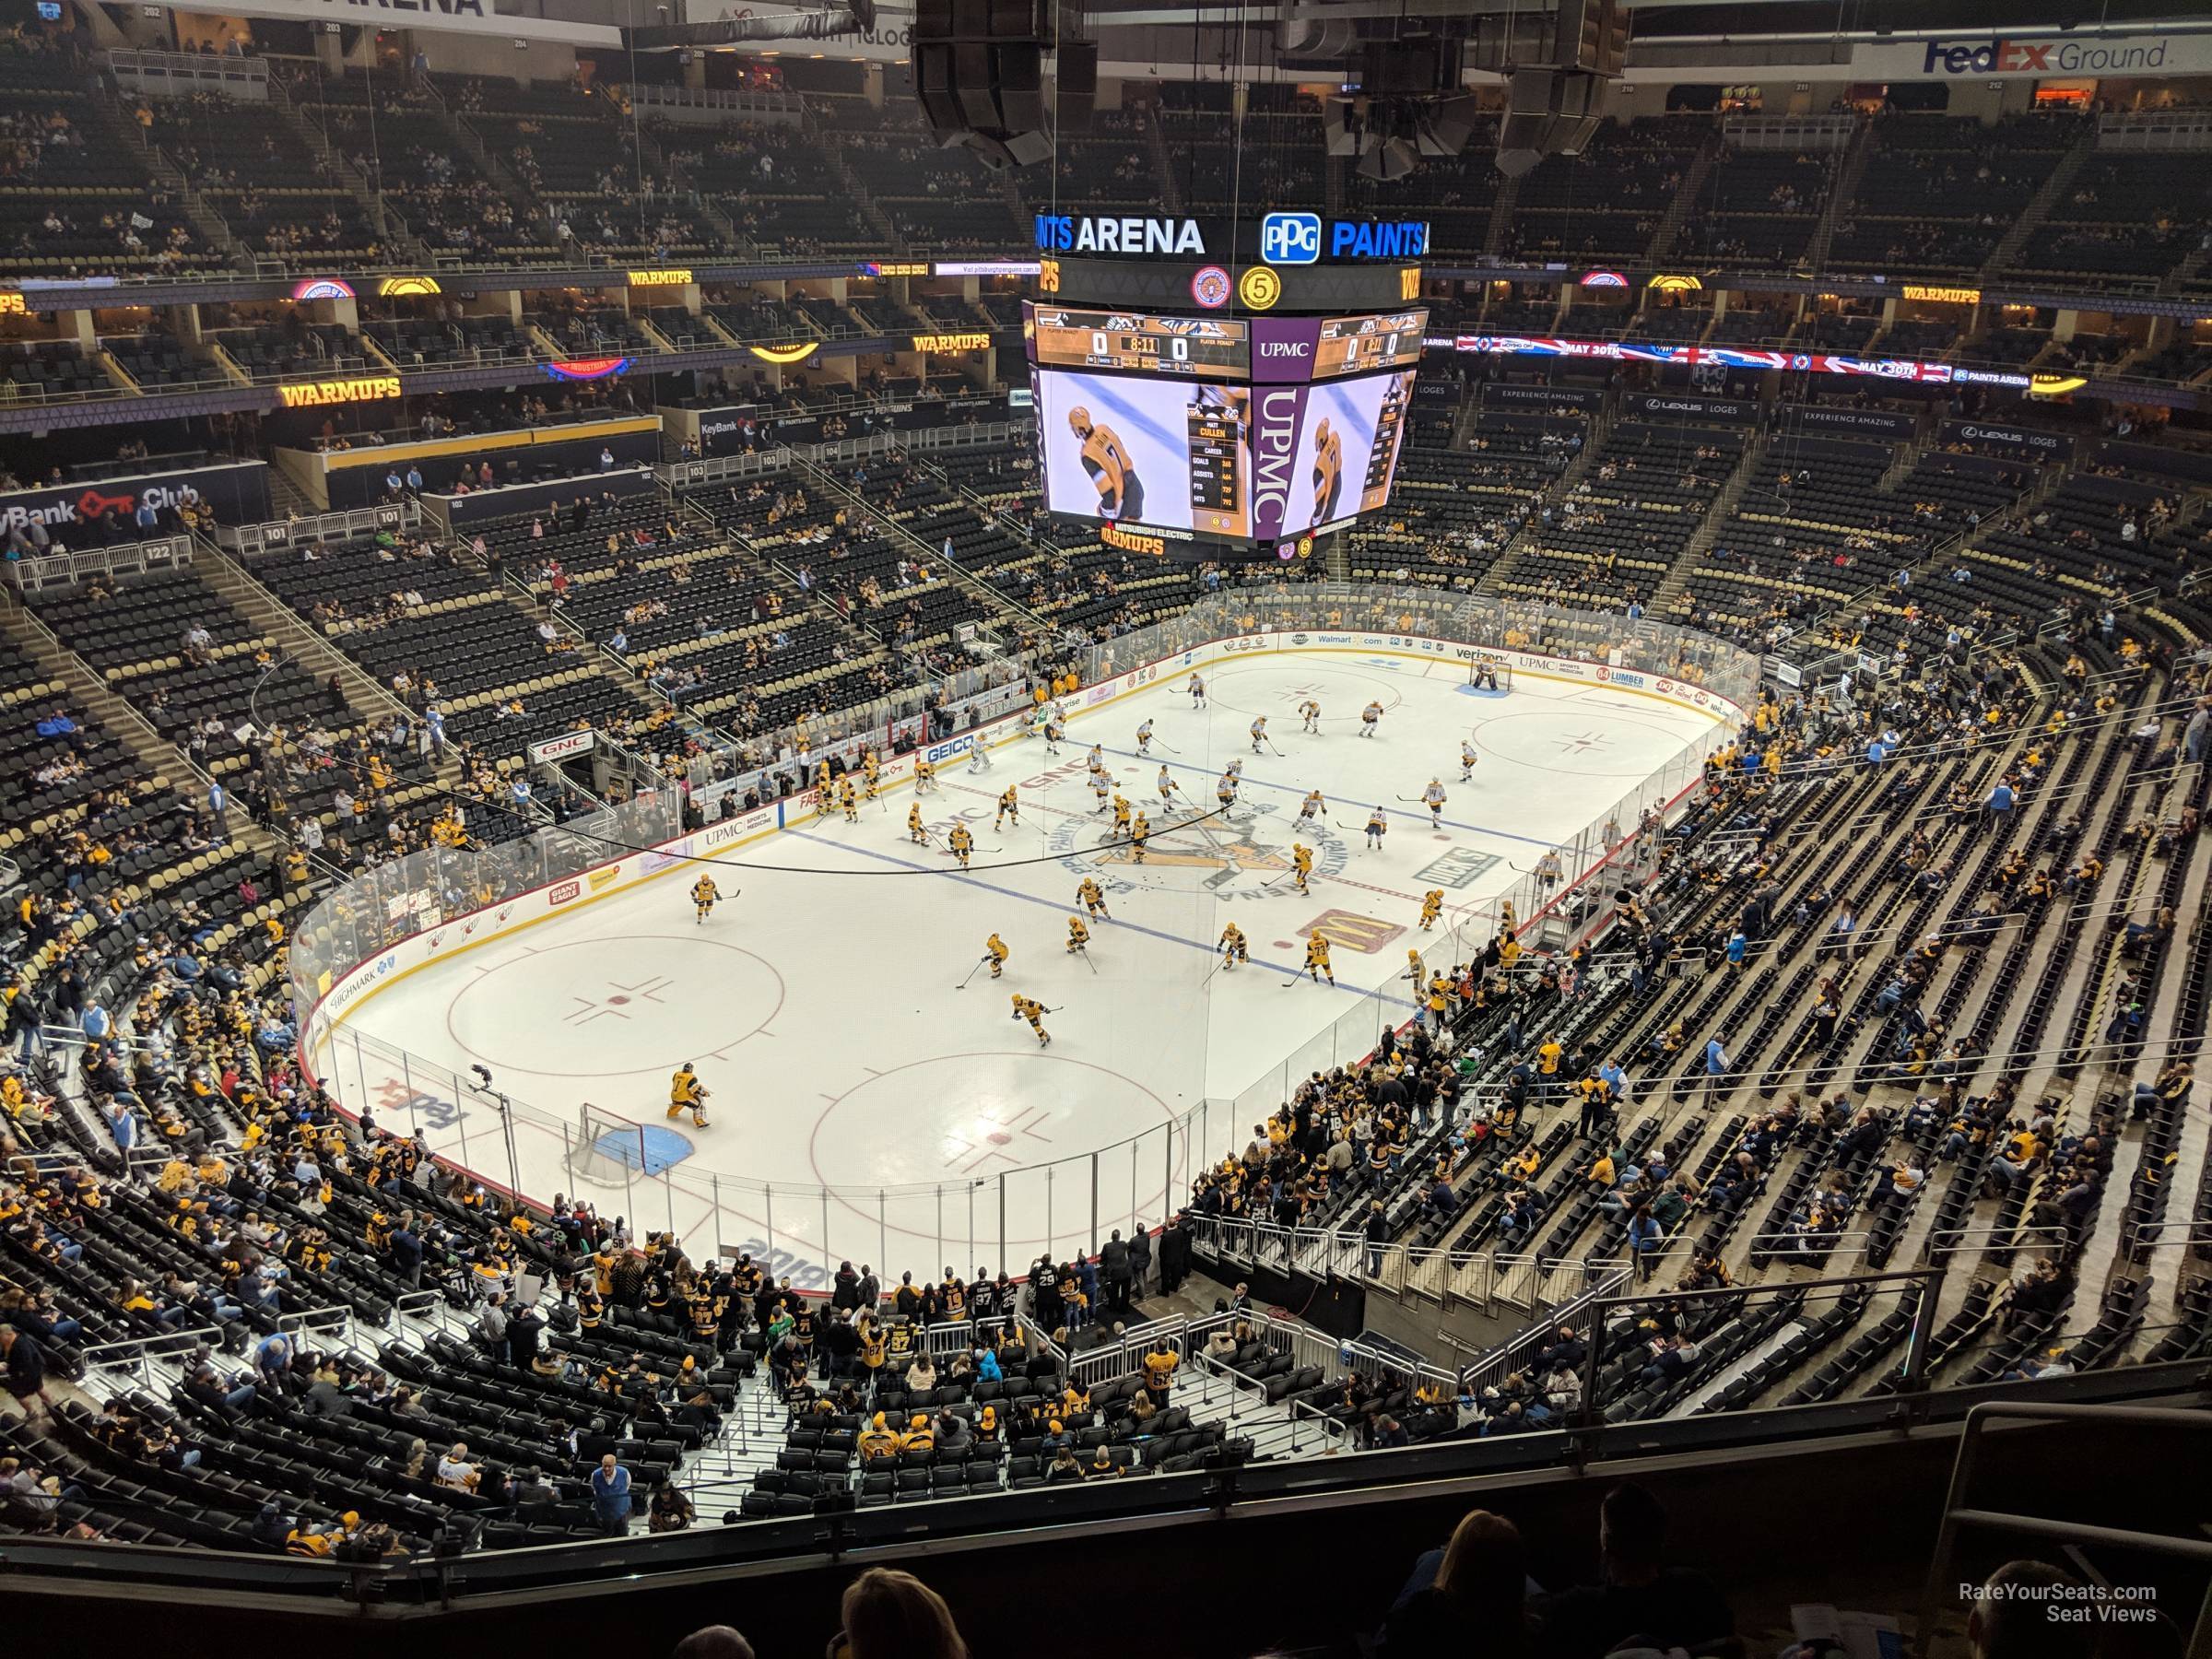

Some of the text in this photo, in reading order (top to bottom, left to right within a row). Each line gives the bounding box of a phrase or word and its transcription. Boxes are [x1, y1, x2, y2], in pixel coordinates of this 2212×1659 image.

[144, 7, 160, 17] 202
[326, 23, 340, 32] 203
[515, 40, 527, 48] 204
[1924, 40, 2168, 73] FedEx Ground
[1077, 218, 1206, 253] ARENA
[1265, 219, 1422, 258] PPG PAINTS
[628, 270, 693, 286] WARMUPS
[1253, 278, 1267, 299] 5
[1902, 286, 1981, 303] WARMUPS
[912, 335, 990, 351] WARMUPS
[1092, 332, 1187, 360] 0 8:11 0
[1261, 343, 1310, 357] UPMC
[1566, 345, 1620, 356] MAY 30TH
[1858, 361, 1918, 376] MAY 30TH
[1969, 372, 1999, 382] PAINTS
[2000, 375, 2030, 386] ARENA
[280, 377, 402, 407] WARMUPS
[1419, 386, 1445, 394] LOGES
[1502, 390, 1584, 402] EXPERIENCE AMAZING
[1662, 402, 1737, 414] LEXUS LOGES
[1805, 412, 1896, 427] EXPERIENCE AMAZING
[701, 421, 737, 436] KeyBank
[1010, 426, 1022, 434] 104
[1200, 428, 1226, 438] CULLEN
[1979, 429, 2057, 448] LEXUS LOGES
[826, 447, 837, 456] 104
[1253, 389, 1297, 524] UPMC
[763, 455, 776, 466] 103
[689, 466, 704, 477] 103
[1194, 470, 1214, 479] ASSISTS
[143, 484, 199, 511] Club
[381, 512, 398, 523] 101
[266, 528, 286, 540] 101
[1115, 523, 1194, 541] MITSUBISHI ELECTRIC
[1100, 526, 1164, 556] WARMUPS
[147, 546, 171, 559] 122
[1318, 635, 1352, 643] Walmart
[1520, 657, 1555, 671] UPMC
[1559, 667, 1584, 677] MEDICINE
[1611, 672, 1644, 686] LUMBER
[542, 735, 586, 755] GNC
[927, 735, 974, 763] GEICO
[1018, 757, 1090, 788] GNC
[747, 813, 767, 824] SPORTS
[747, 818, 772, 830] MEDICINE
[706, 822, 743, 845] UPMC
[552, 883, 577, 897] GIANT
[553, 890, 577, 902] EAGLE
[1314, 945, 1326, 957] 73
[334, 971, 377, 1009] HIGHMARK
[612, 1239, 625, 1250] 58
[599, 1266, 606, 1281] 7
[1039, 1275, 1055, 1287] 29
[947, 1294, 963, 1310] 19
